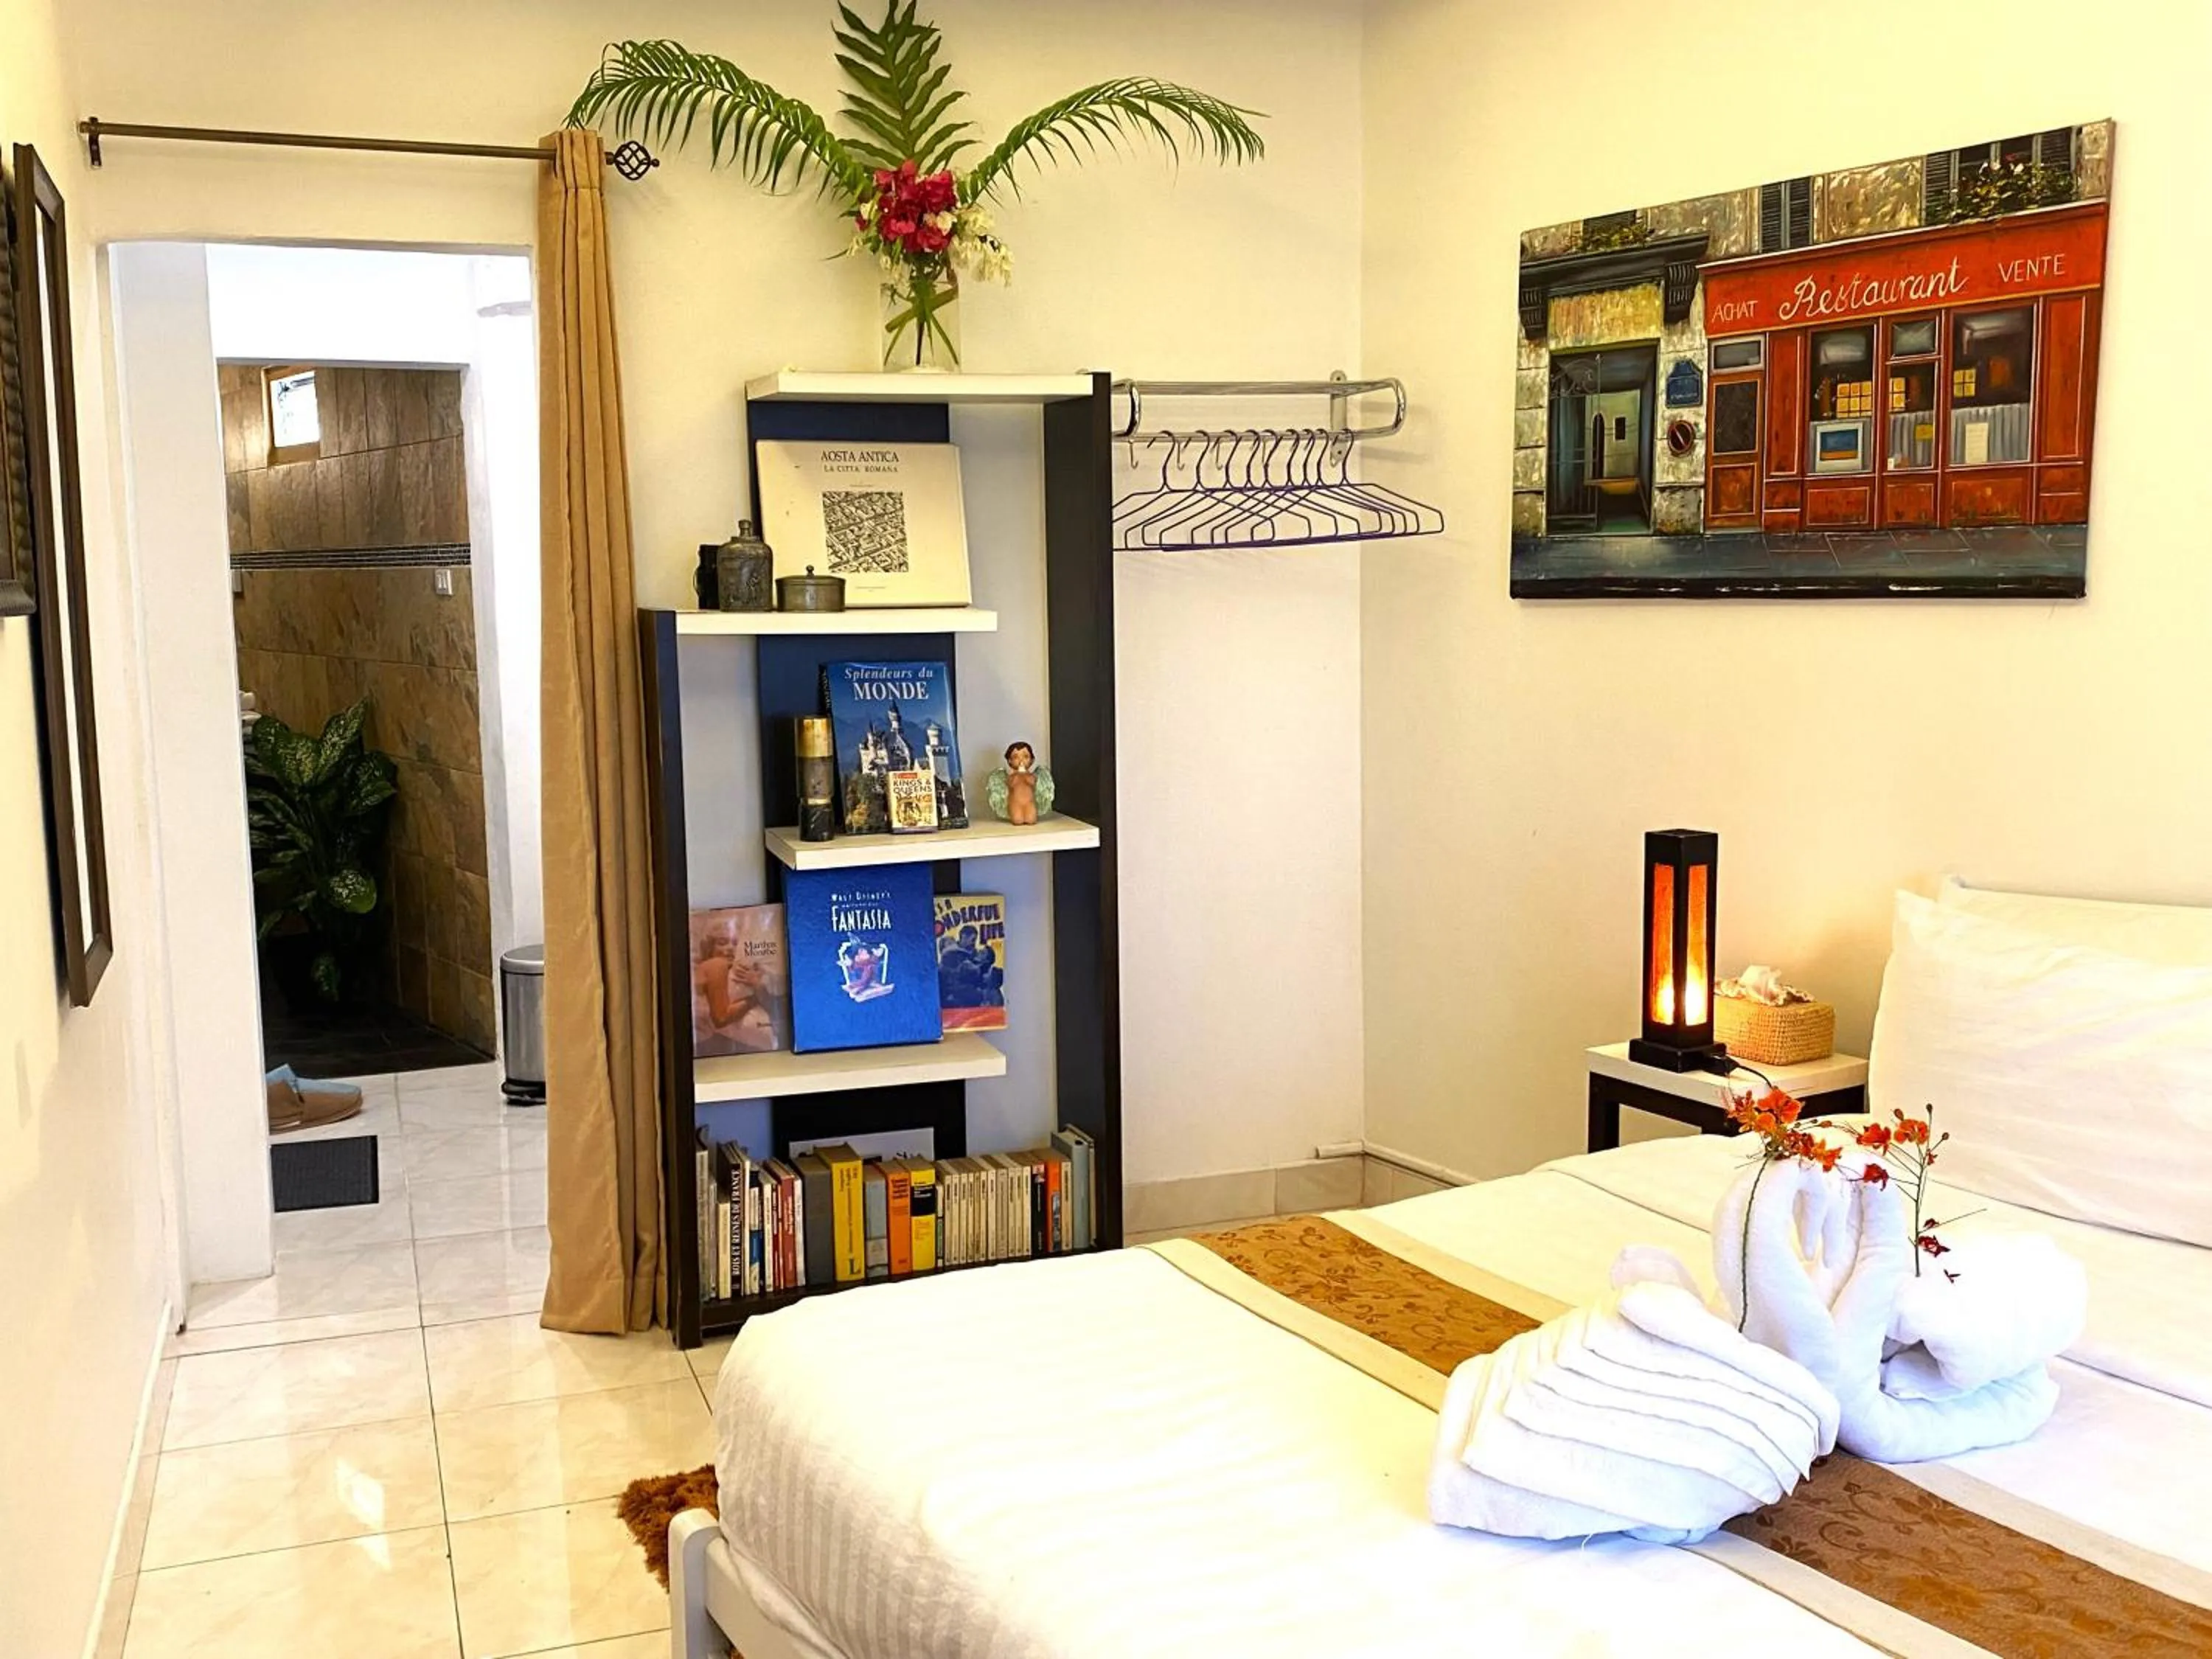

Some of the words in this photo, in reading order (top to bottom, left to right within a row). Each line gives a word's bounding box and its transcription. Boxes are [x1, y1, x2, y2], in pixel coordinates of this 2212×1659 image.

[1711, 300, 1758, 323] ACHAT
[1779, 257, 1969, 321] Restaurant
[1998, 254, 2065, 283] VENTE
[821, 450, 856, 462] AOSTA
[858, 450, 900, 462] ANTICA
[824, 464, 835, 473] LA
[845, 667, 912, 681] Splendeurs
[918, 667, 933, 678] du
[853, 681, 929, 700] MONDE
[831, 905, 891, 932] FANTASIA
[934, 903, 1001, 937] ONDERFUL
[980, 922, 1005, 945] LIFE
